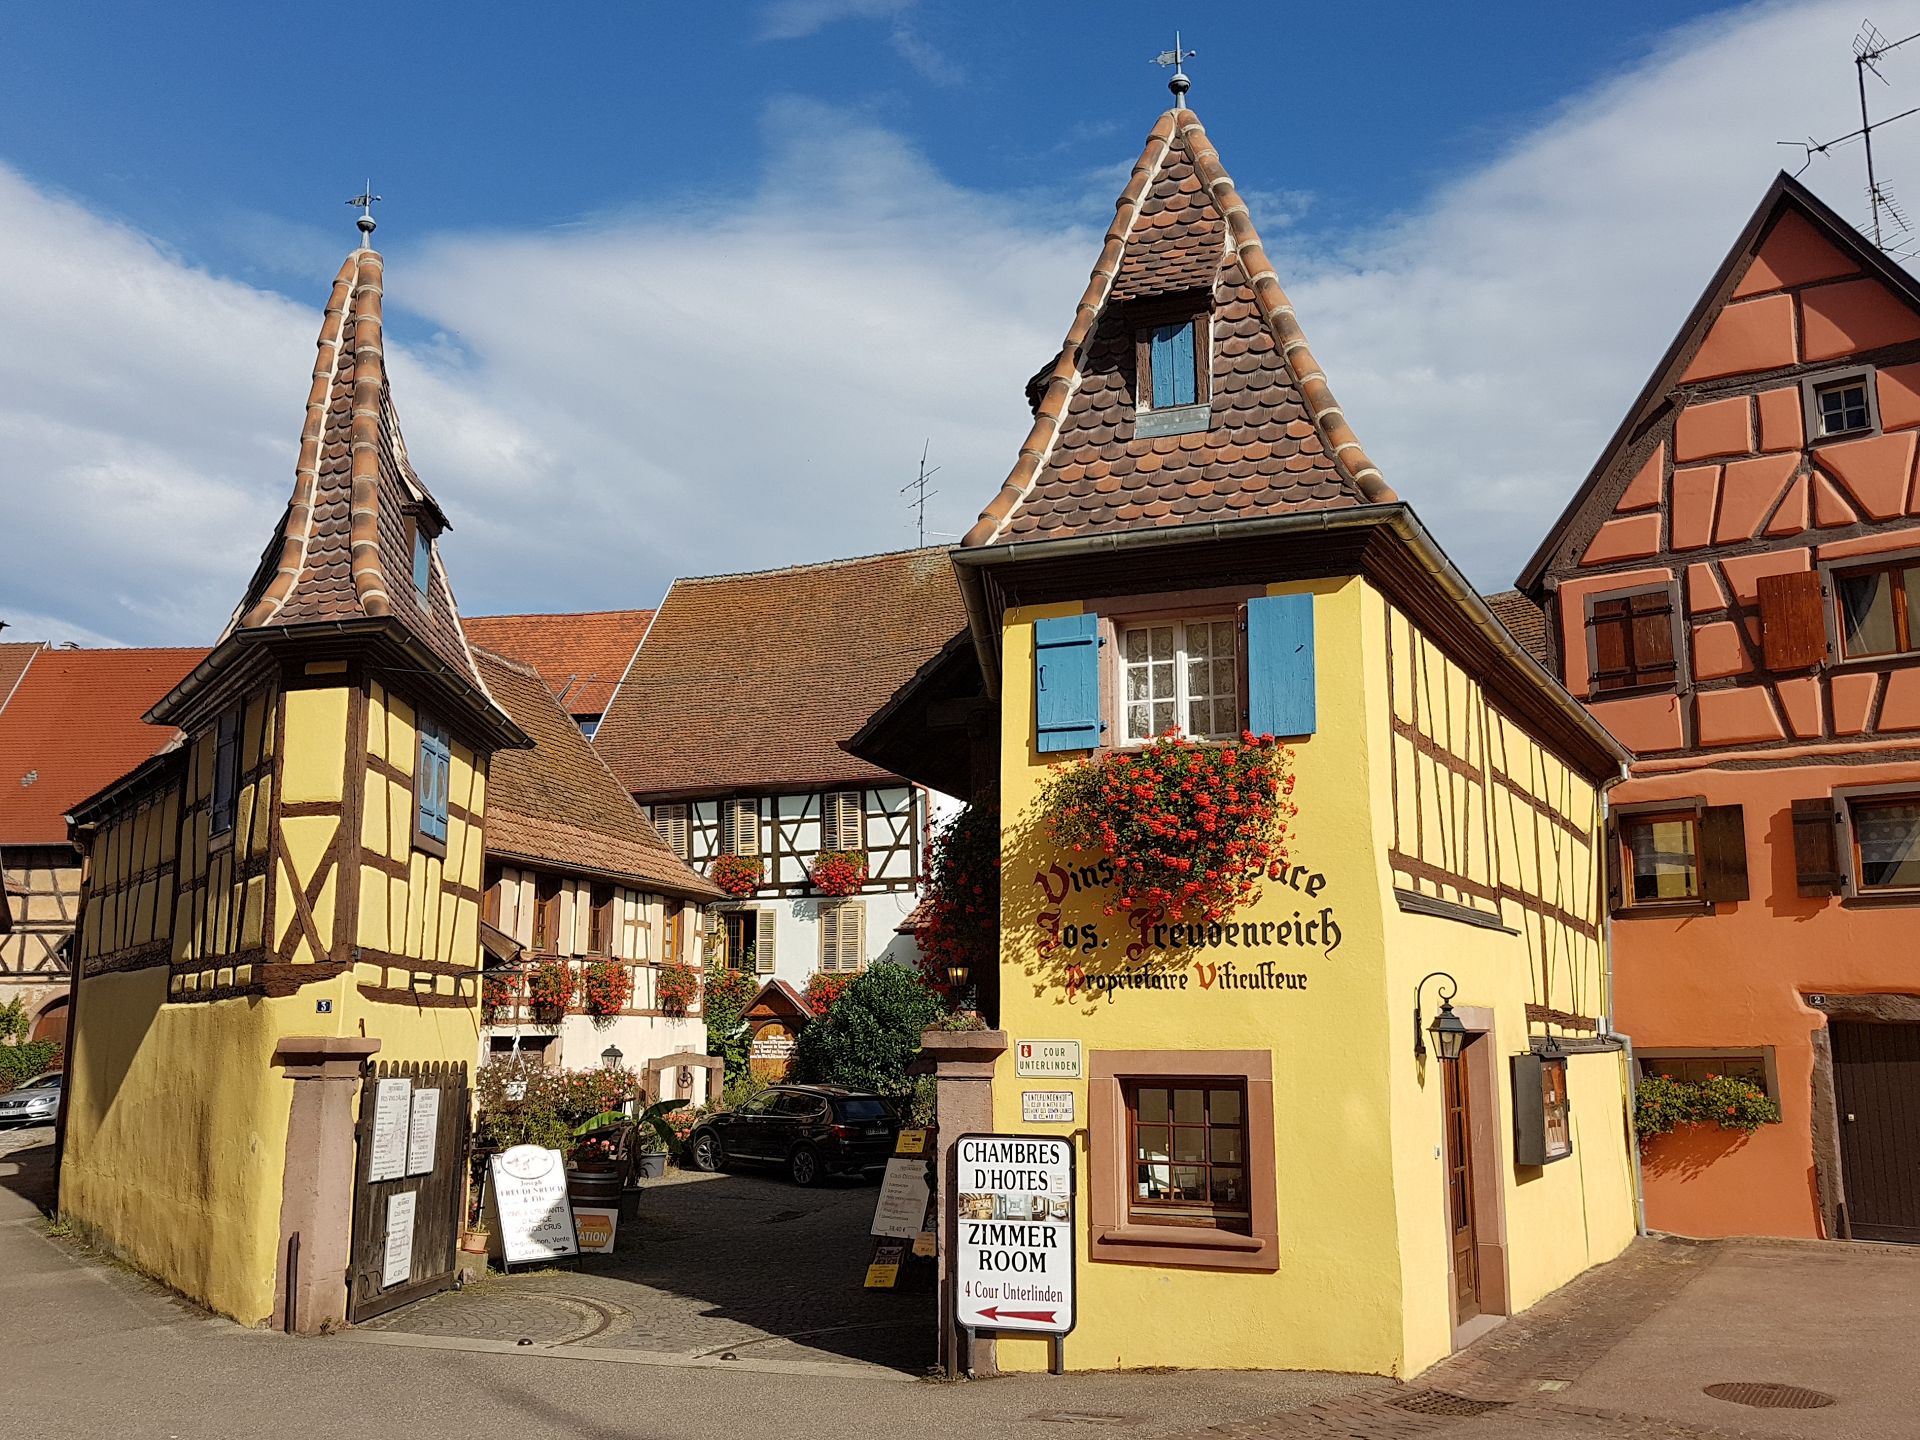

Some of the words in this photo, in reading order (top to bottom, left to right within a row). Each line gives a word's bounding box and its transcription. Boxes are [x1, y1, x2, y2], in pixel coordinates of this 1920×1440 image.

[1033, 857, 1115, 905] Vins
[1036, 908, 1108, 960] Jos.
[1126, 905, 1342, 962] Freudenreich
[1193, 961, 1308, 991] Viticulteur
[1043, 1047, 1065, 1057] COUR
[1019, 1060, 1077, 1071] UNTERLINDEN
[963, 1142, 1060, 1165] CHAMBRES
[974, 1168, 1048, 1191] D'HOTES
[543, 1222, 562, 1231] CRUS
[968, 1223, 1057, 1248] ZIMMER
[979, 1249, 1046, 1273] ROOM
[965, 1280, 971, 1297] 4
[975, 1280, 999, 1299] Cour
[1003, 1282, 1063, 1303] Unterlinden
